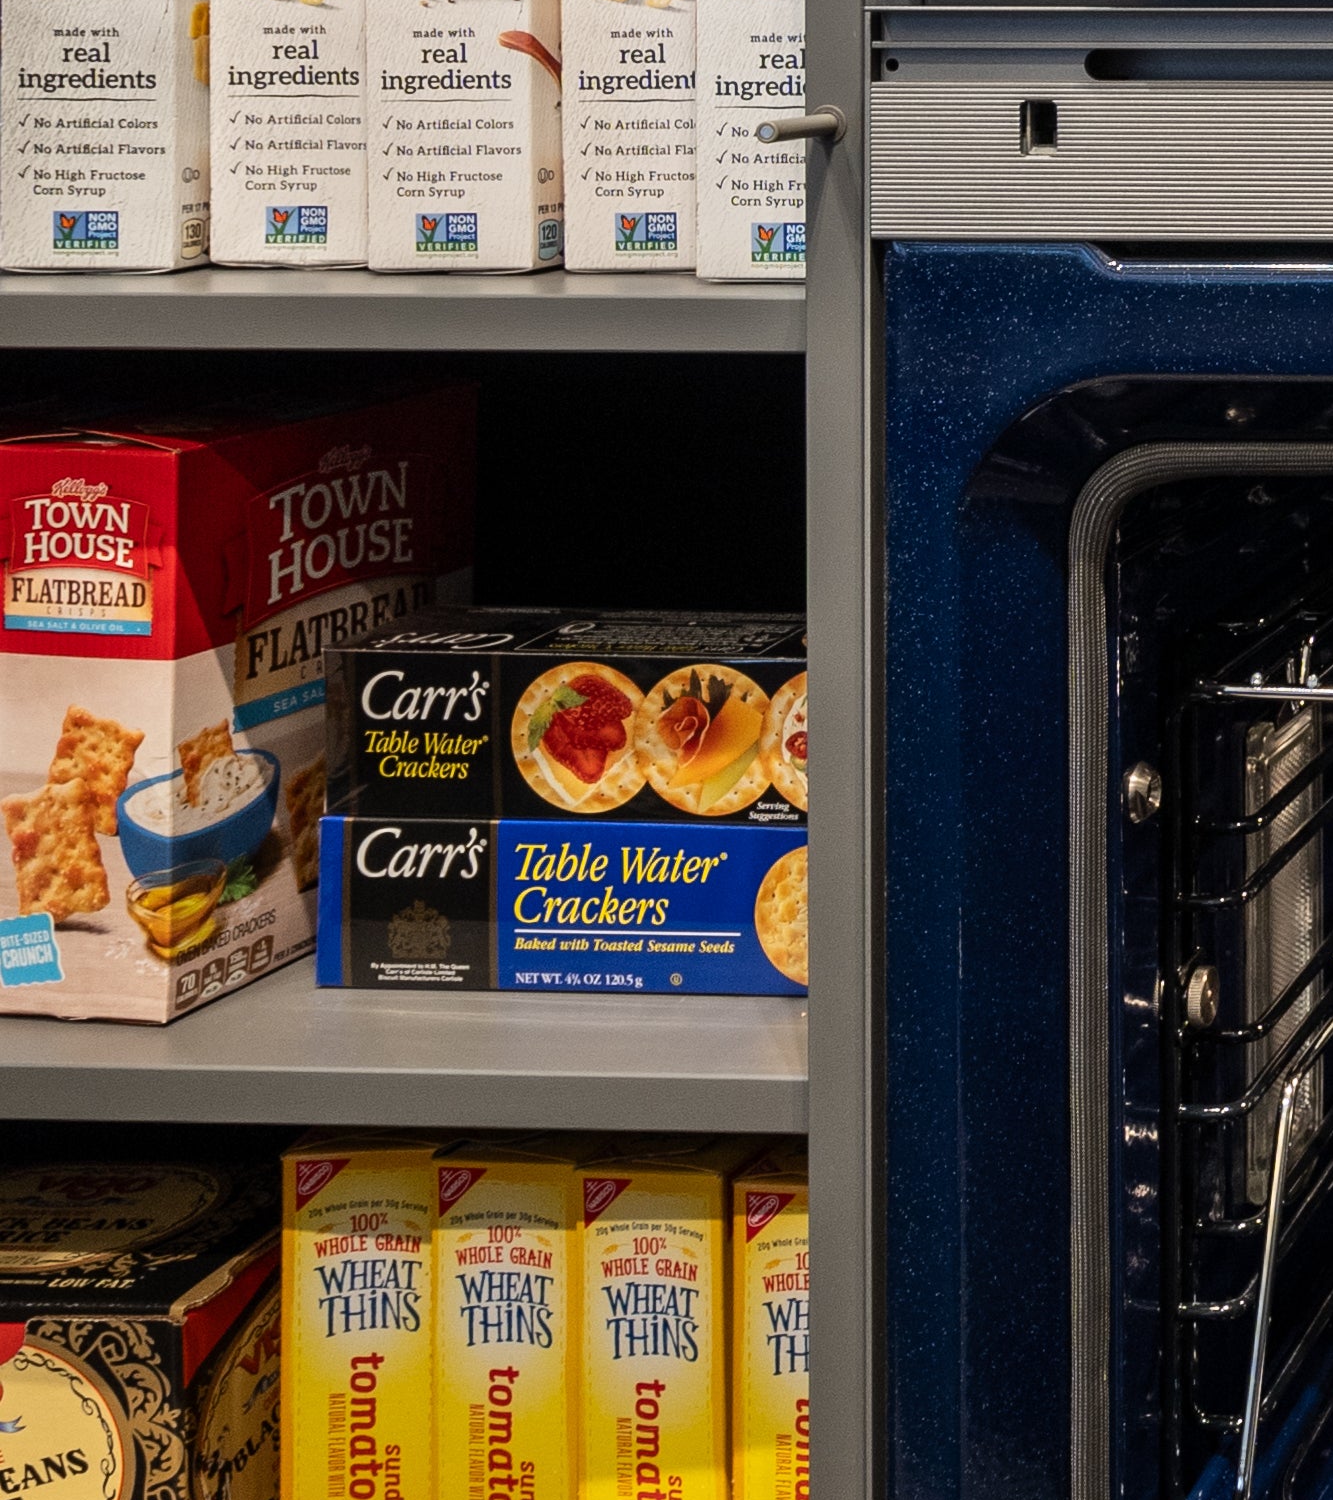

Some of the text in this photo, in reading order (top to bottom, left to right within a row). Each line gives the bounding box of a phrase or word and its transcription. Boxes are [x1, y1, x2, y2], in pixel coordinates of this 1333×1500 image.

[62, 43, 111, 62] real
[18, 68, 156, 92] ingredients
[397, 171, 502, 182] No High Fructose
[397, 187, 465, 199] Corn Syrup
[88, 222, 116, 231] GMO
[89, 213, 116, 222] NON
[56, 240, 116, 248] VERIFIED
[51, 477, 108, 502] Kellogg's
[24, 499, 130, 533] TOWN
[24, 531, 133, 568] HOUSE
[12, 577, 145, 607] FLATBREAD
[361, 671, 486, 721] Carr's
[365, 731, 483, 755] Table Water
[379, 756, 468, 779] Crackers
[357, 828, 484, 878] Carr's
[515, 843, 719, 884] Table Water
[514, 886, 669, 925] Crackers
[0, 945, 53, 969] CRUNCH
[514, 938, 734, 953] Baked with Toasted Sesame Seeds
[516, 972, 602, 985] NET OZ
[350, 1212, 388, 1233] 100%
[314, 1234, 422, 1258] WHOLE GRAIN
[48, 1277, 94, 1289] LOW
[314, 1259, 422, 1295] WHEAT
[349, 1352, 384, 1500] tomato
